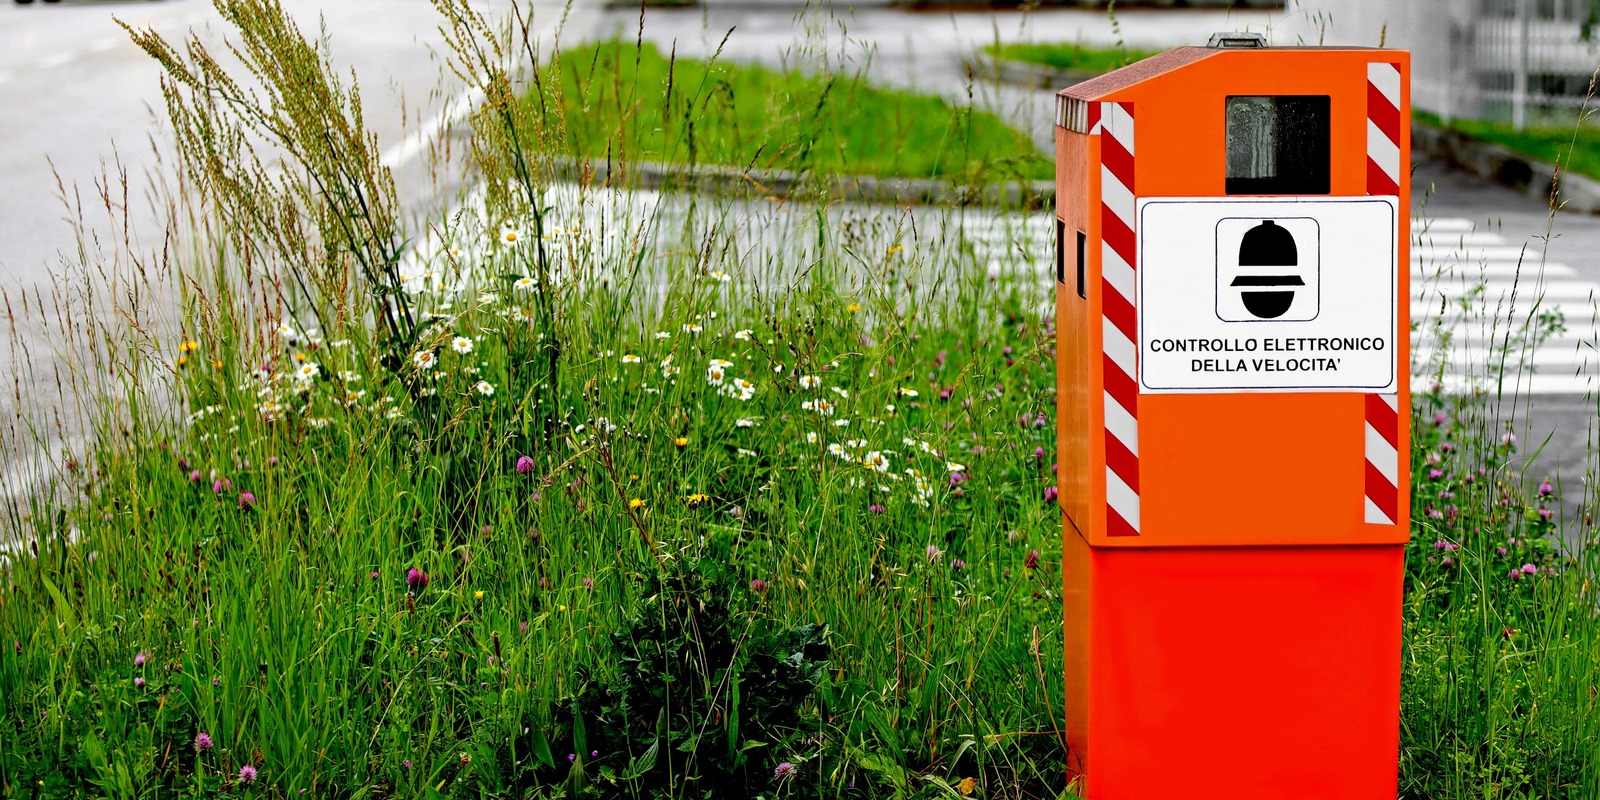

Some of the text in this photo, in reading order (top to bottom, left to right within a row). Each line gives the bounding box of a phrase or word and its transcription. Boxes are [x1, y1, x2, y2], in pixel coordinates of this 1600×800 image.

[1150, 337, 1385, 352] CONTROLLO ELETTRONICO
[1191, 358, 1341, 372] DELLA VELOCITA'
